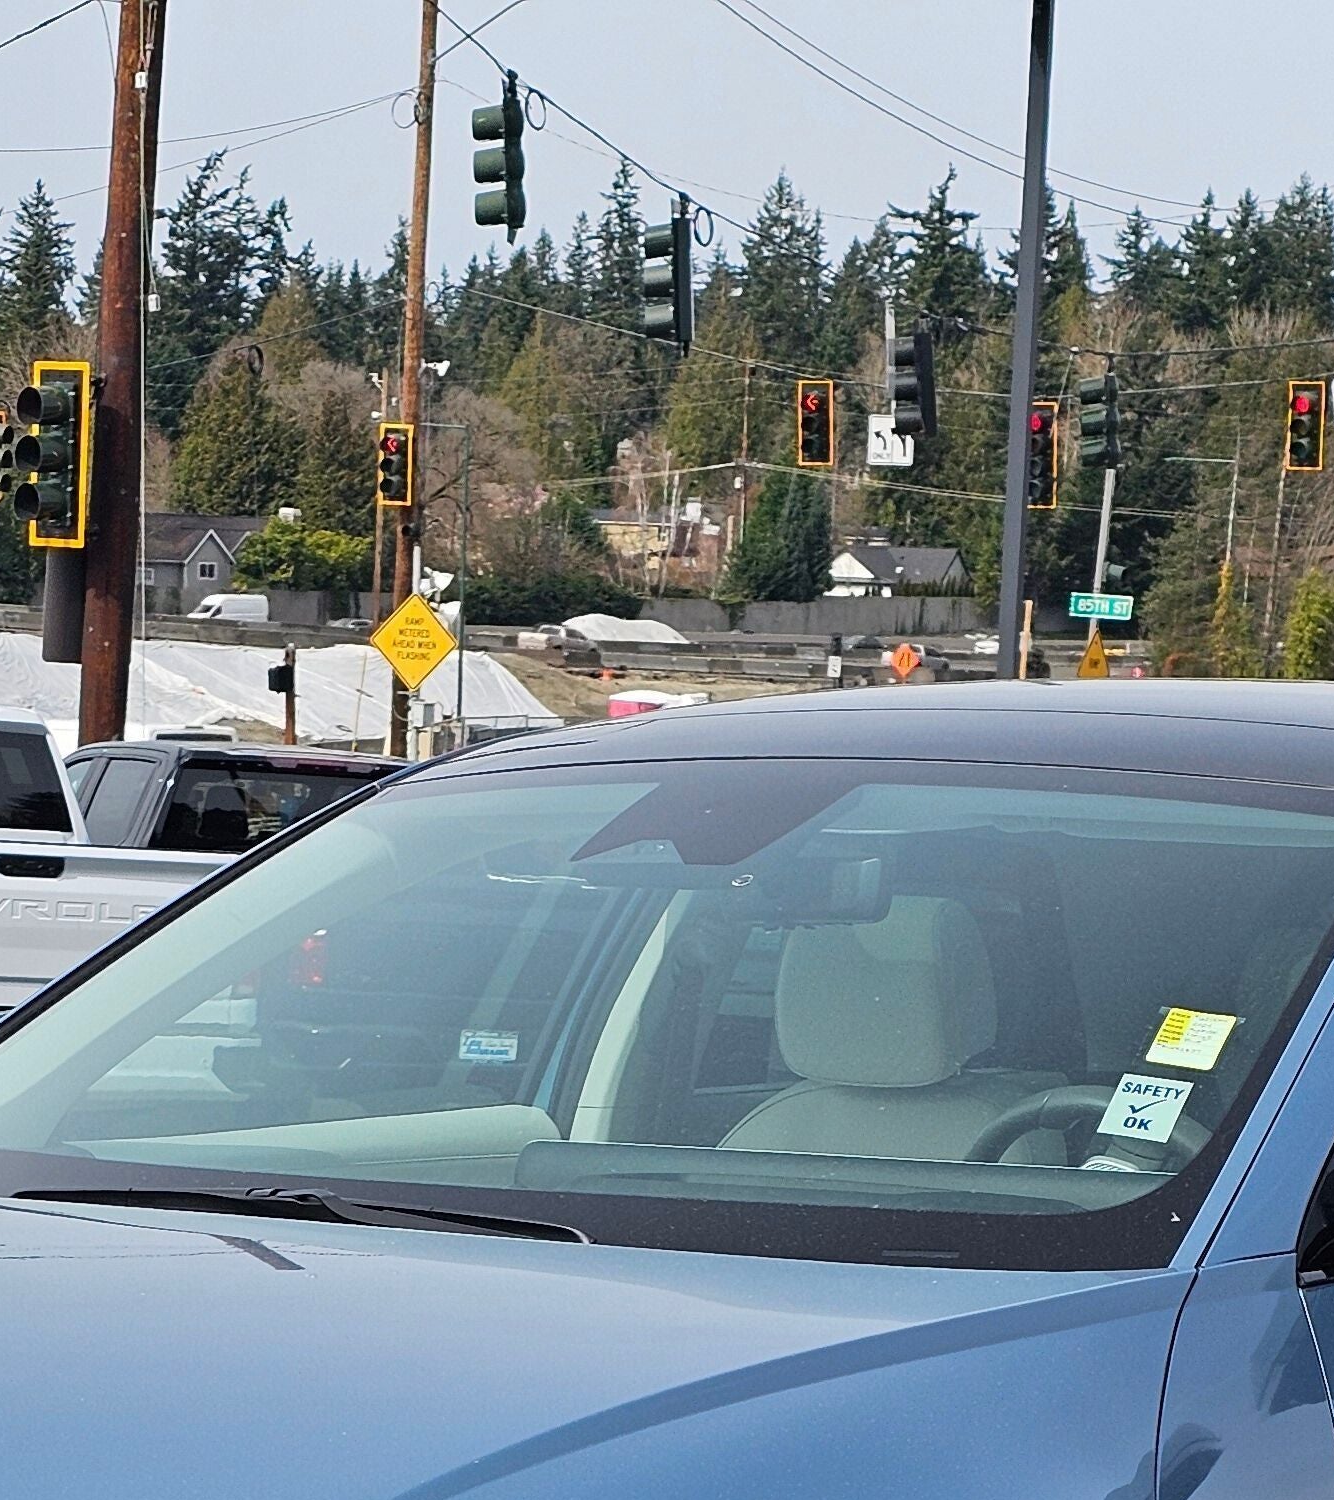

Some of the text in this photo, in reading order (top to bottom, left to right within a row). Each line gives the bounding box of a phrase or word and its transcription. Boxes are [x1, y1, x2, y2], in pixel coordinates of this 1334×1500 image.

[1077, 598, 1130, 615] 85TH ST
[393, 639, 436, 650] AHEAD WHEN
[397, 650, 430, 661] FLASHING
[1121, 1081, 1186, 1100] SAFETY
[1123, 1116, 1153, 1131] OK
